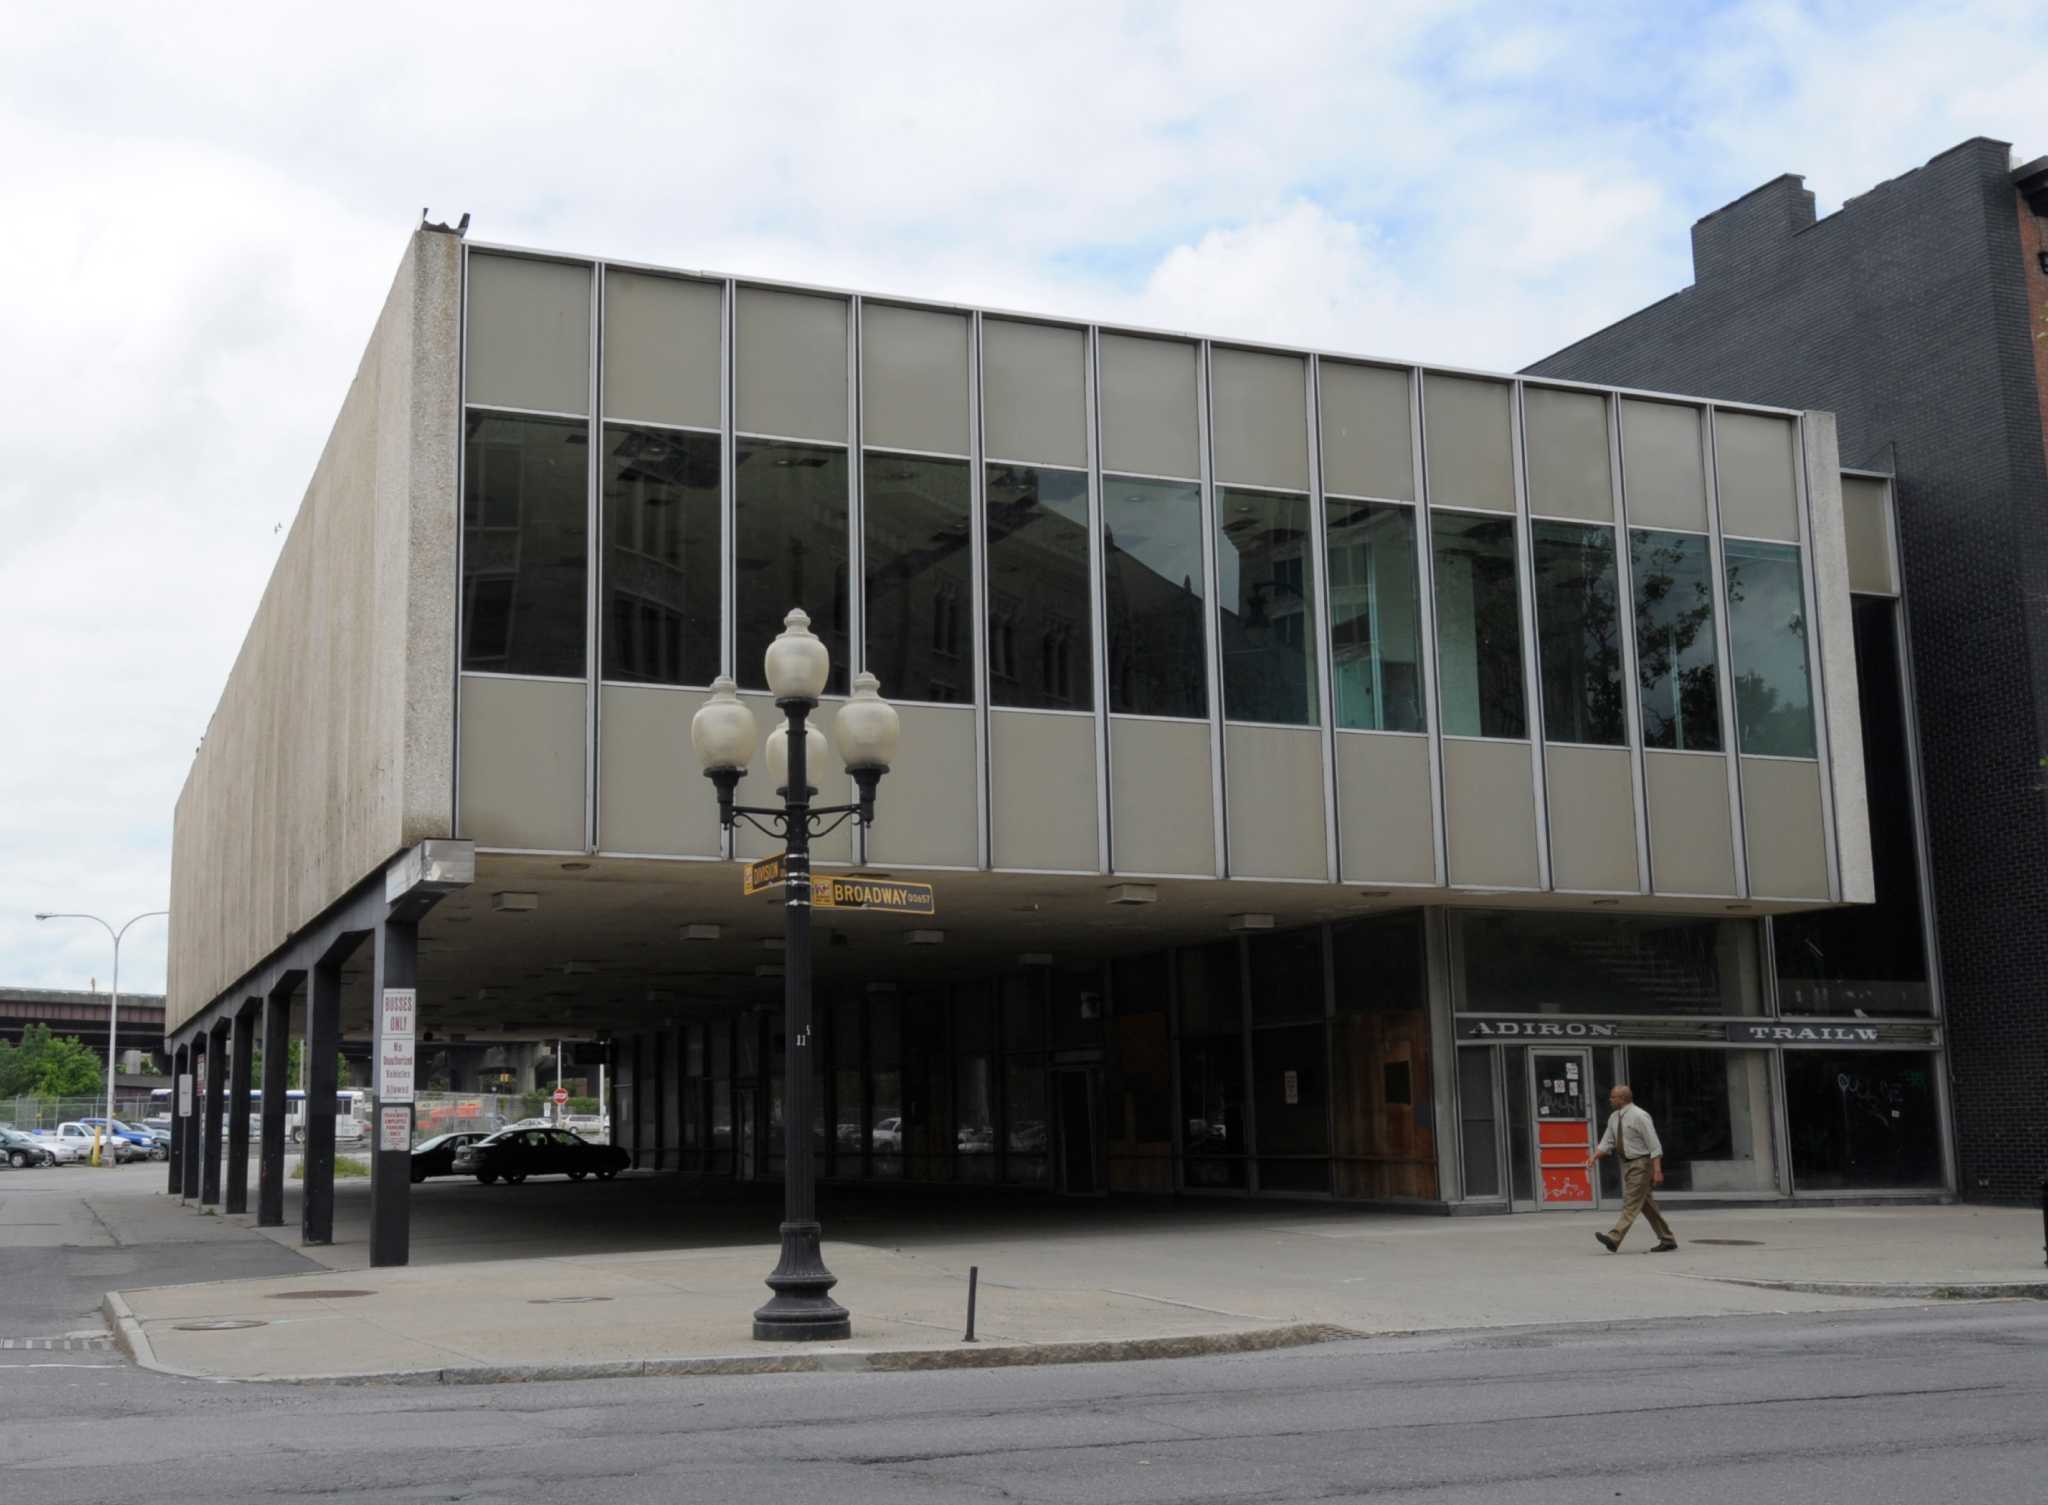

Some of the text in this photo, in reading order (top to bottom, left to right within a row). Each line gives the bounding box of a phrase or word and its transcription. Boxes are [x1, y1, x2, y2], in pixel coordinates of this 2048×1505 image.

[834, 884, 908, 905] BROADWAY
[384, 996, 412, 1012] BUSSES
[390, 1017, 407, 1031] ONLY
[1468, 1021, 1617, 1036] ADIRON
[1749, 1026, 1878, 1040] TRAILW
